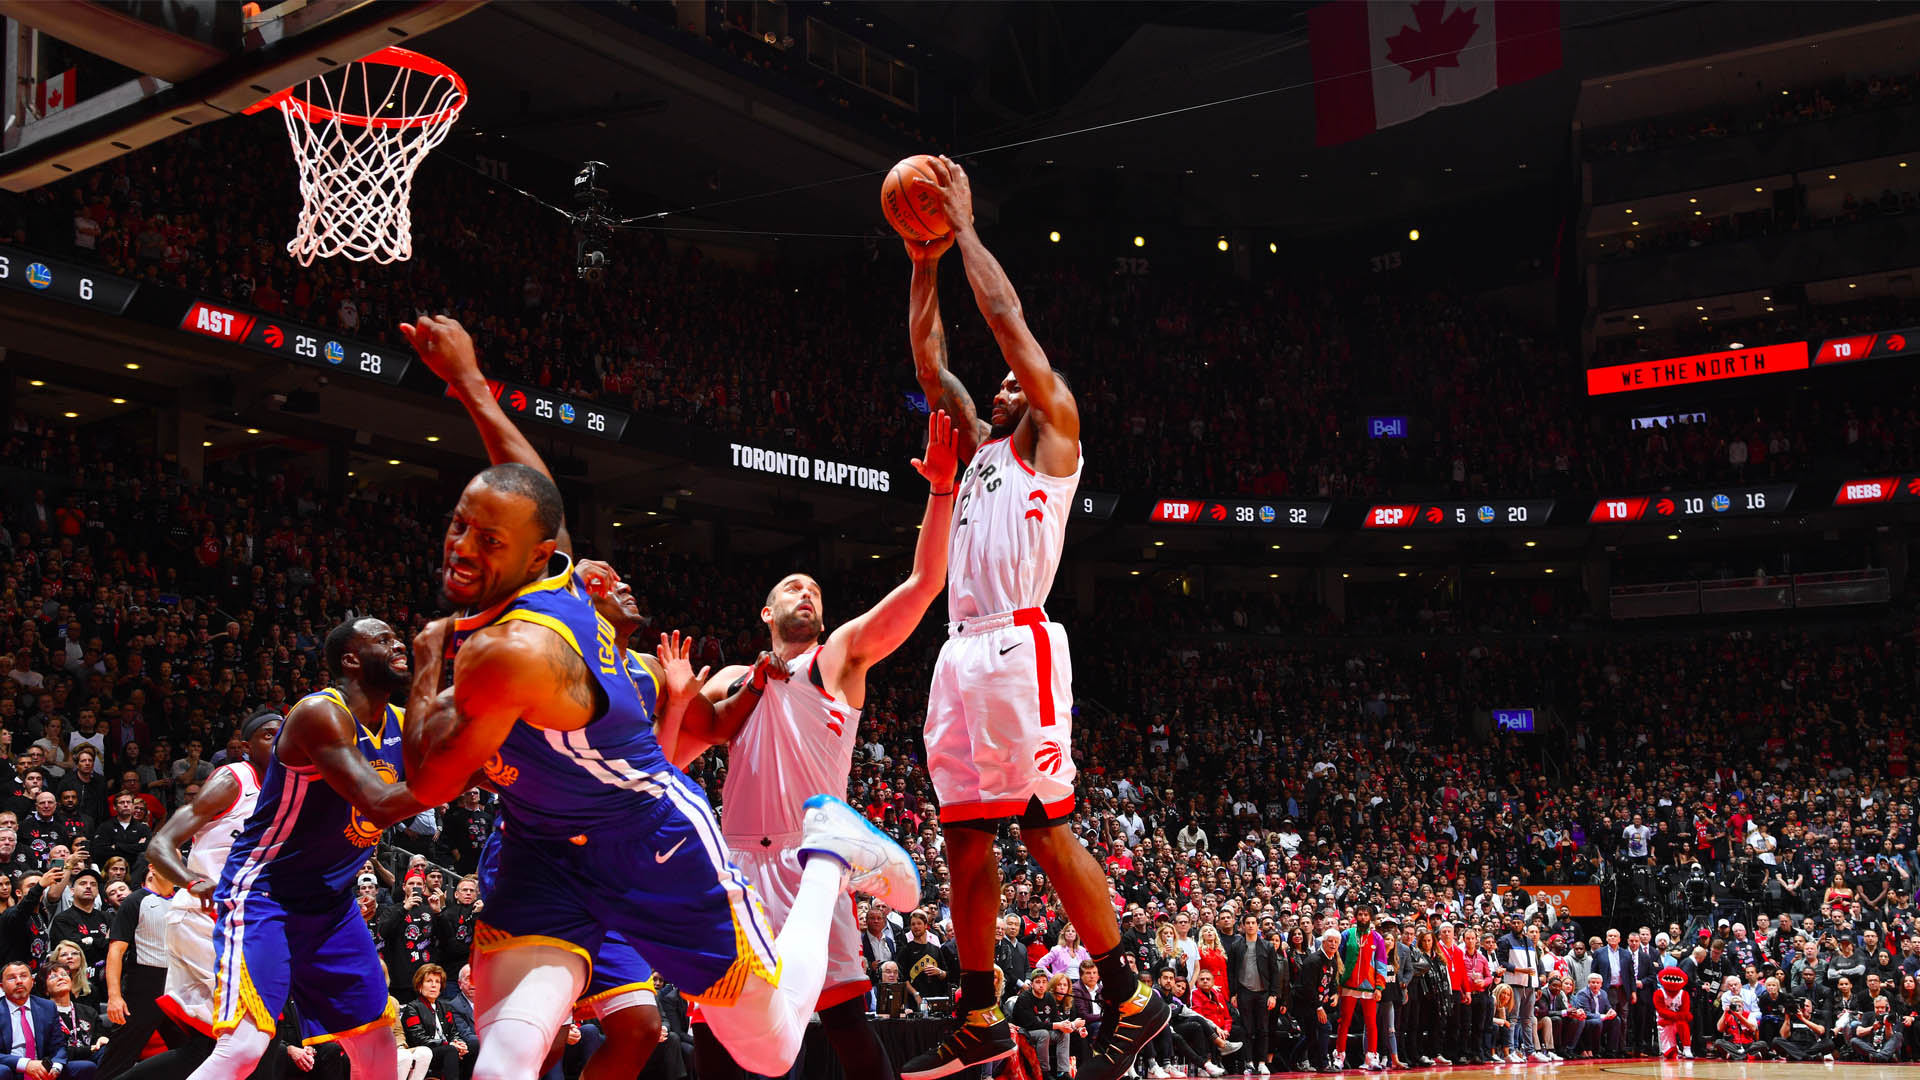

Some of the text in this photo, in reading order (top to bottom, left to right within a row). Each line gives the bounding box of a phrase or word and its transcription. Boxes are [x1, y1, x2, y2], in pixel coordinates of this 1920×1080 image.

[79, 278, 94, 301] 6
[197, 307, 382, 375] AST 25 28
[1833, 343, 1851, 358] TO
[1621, 353, 1765, 386] WE THE NORTH
[535, 398, 605, 432] 25 26
[1374, 419, 1401, 435] Bell
[730, 443, 890, 493] TORONTO RAPTORS
[1846, 483, 1882, 500] REBS
[1083, 498, 1093, 513] 9
[1163, 502, 1307, 524] PIP 38 32
[1374, 506, 1528, 525] 2CP 5 20
[1606, 492, 1766, 519] TO 10 16
[1499, 713, 1527, 729] Bell
